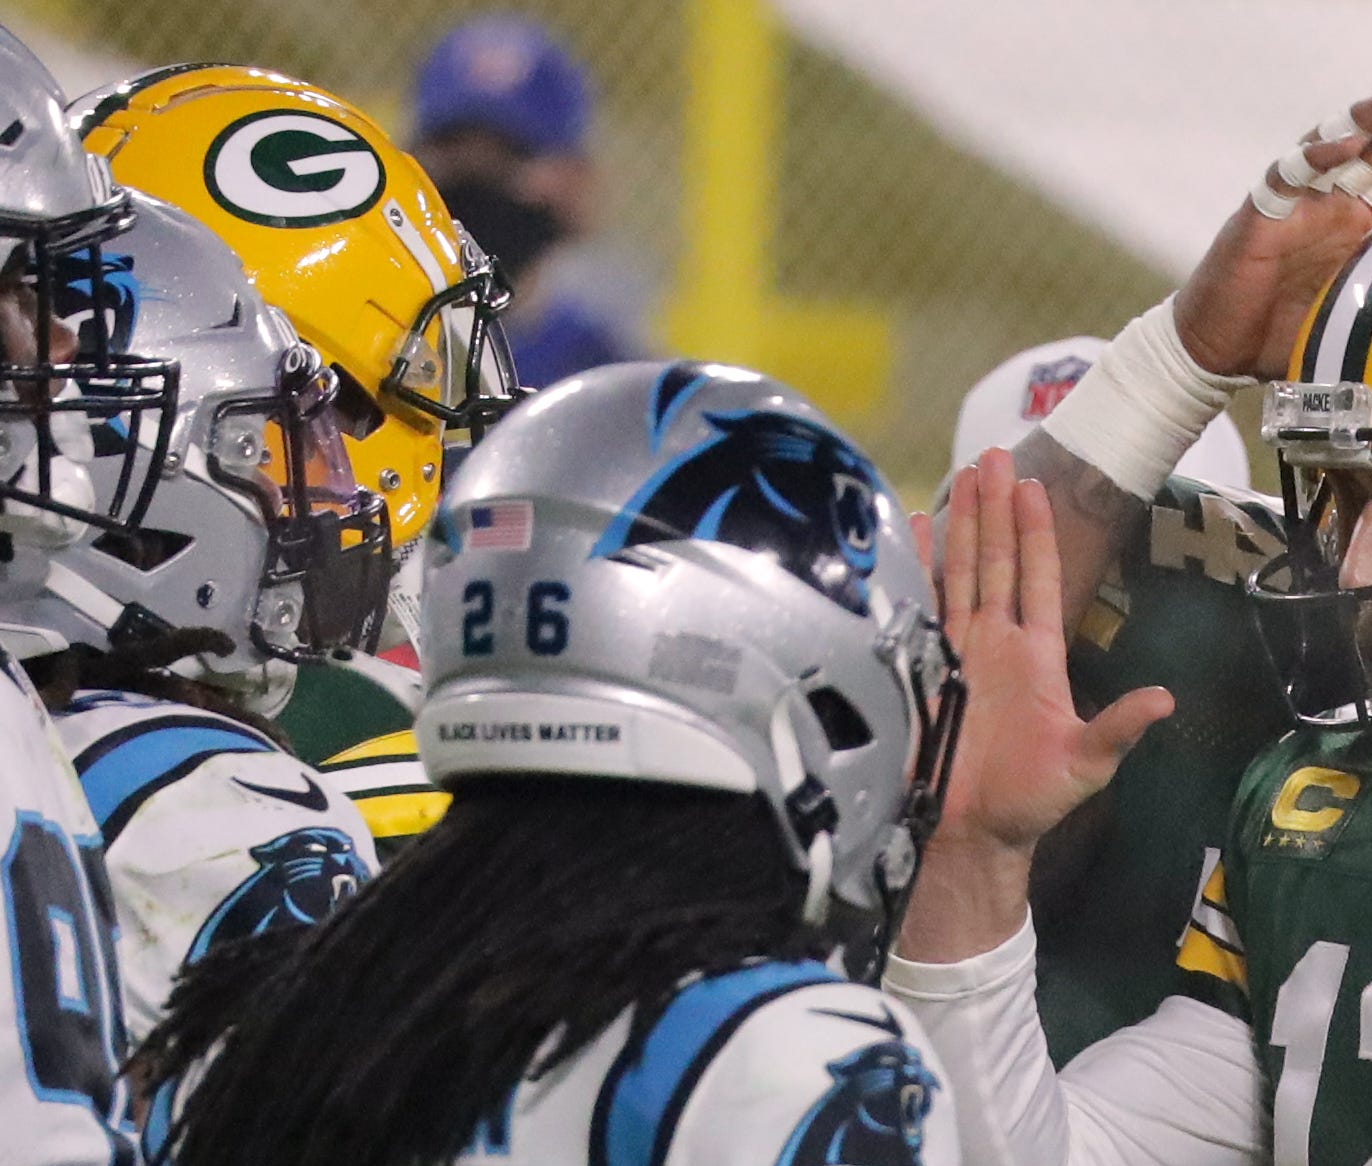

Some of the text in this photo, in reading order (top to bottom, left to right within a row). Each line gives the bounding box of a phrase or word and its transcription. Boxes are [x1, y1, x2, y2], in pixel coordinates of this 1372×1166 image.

[213, 115, 380, 222] G
[482, 723, 532, 741] LIVES
[538, 724, 621, 741] MATTER
[1272, 766, 1360, 832] C
